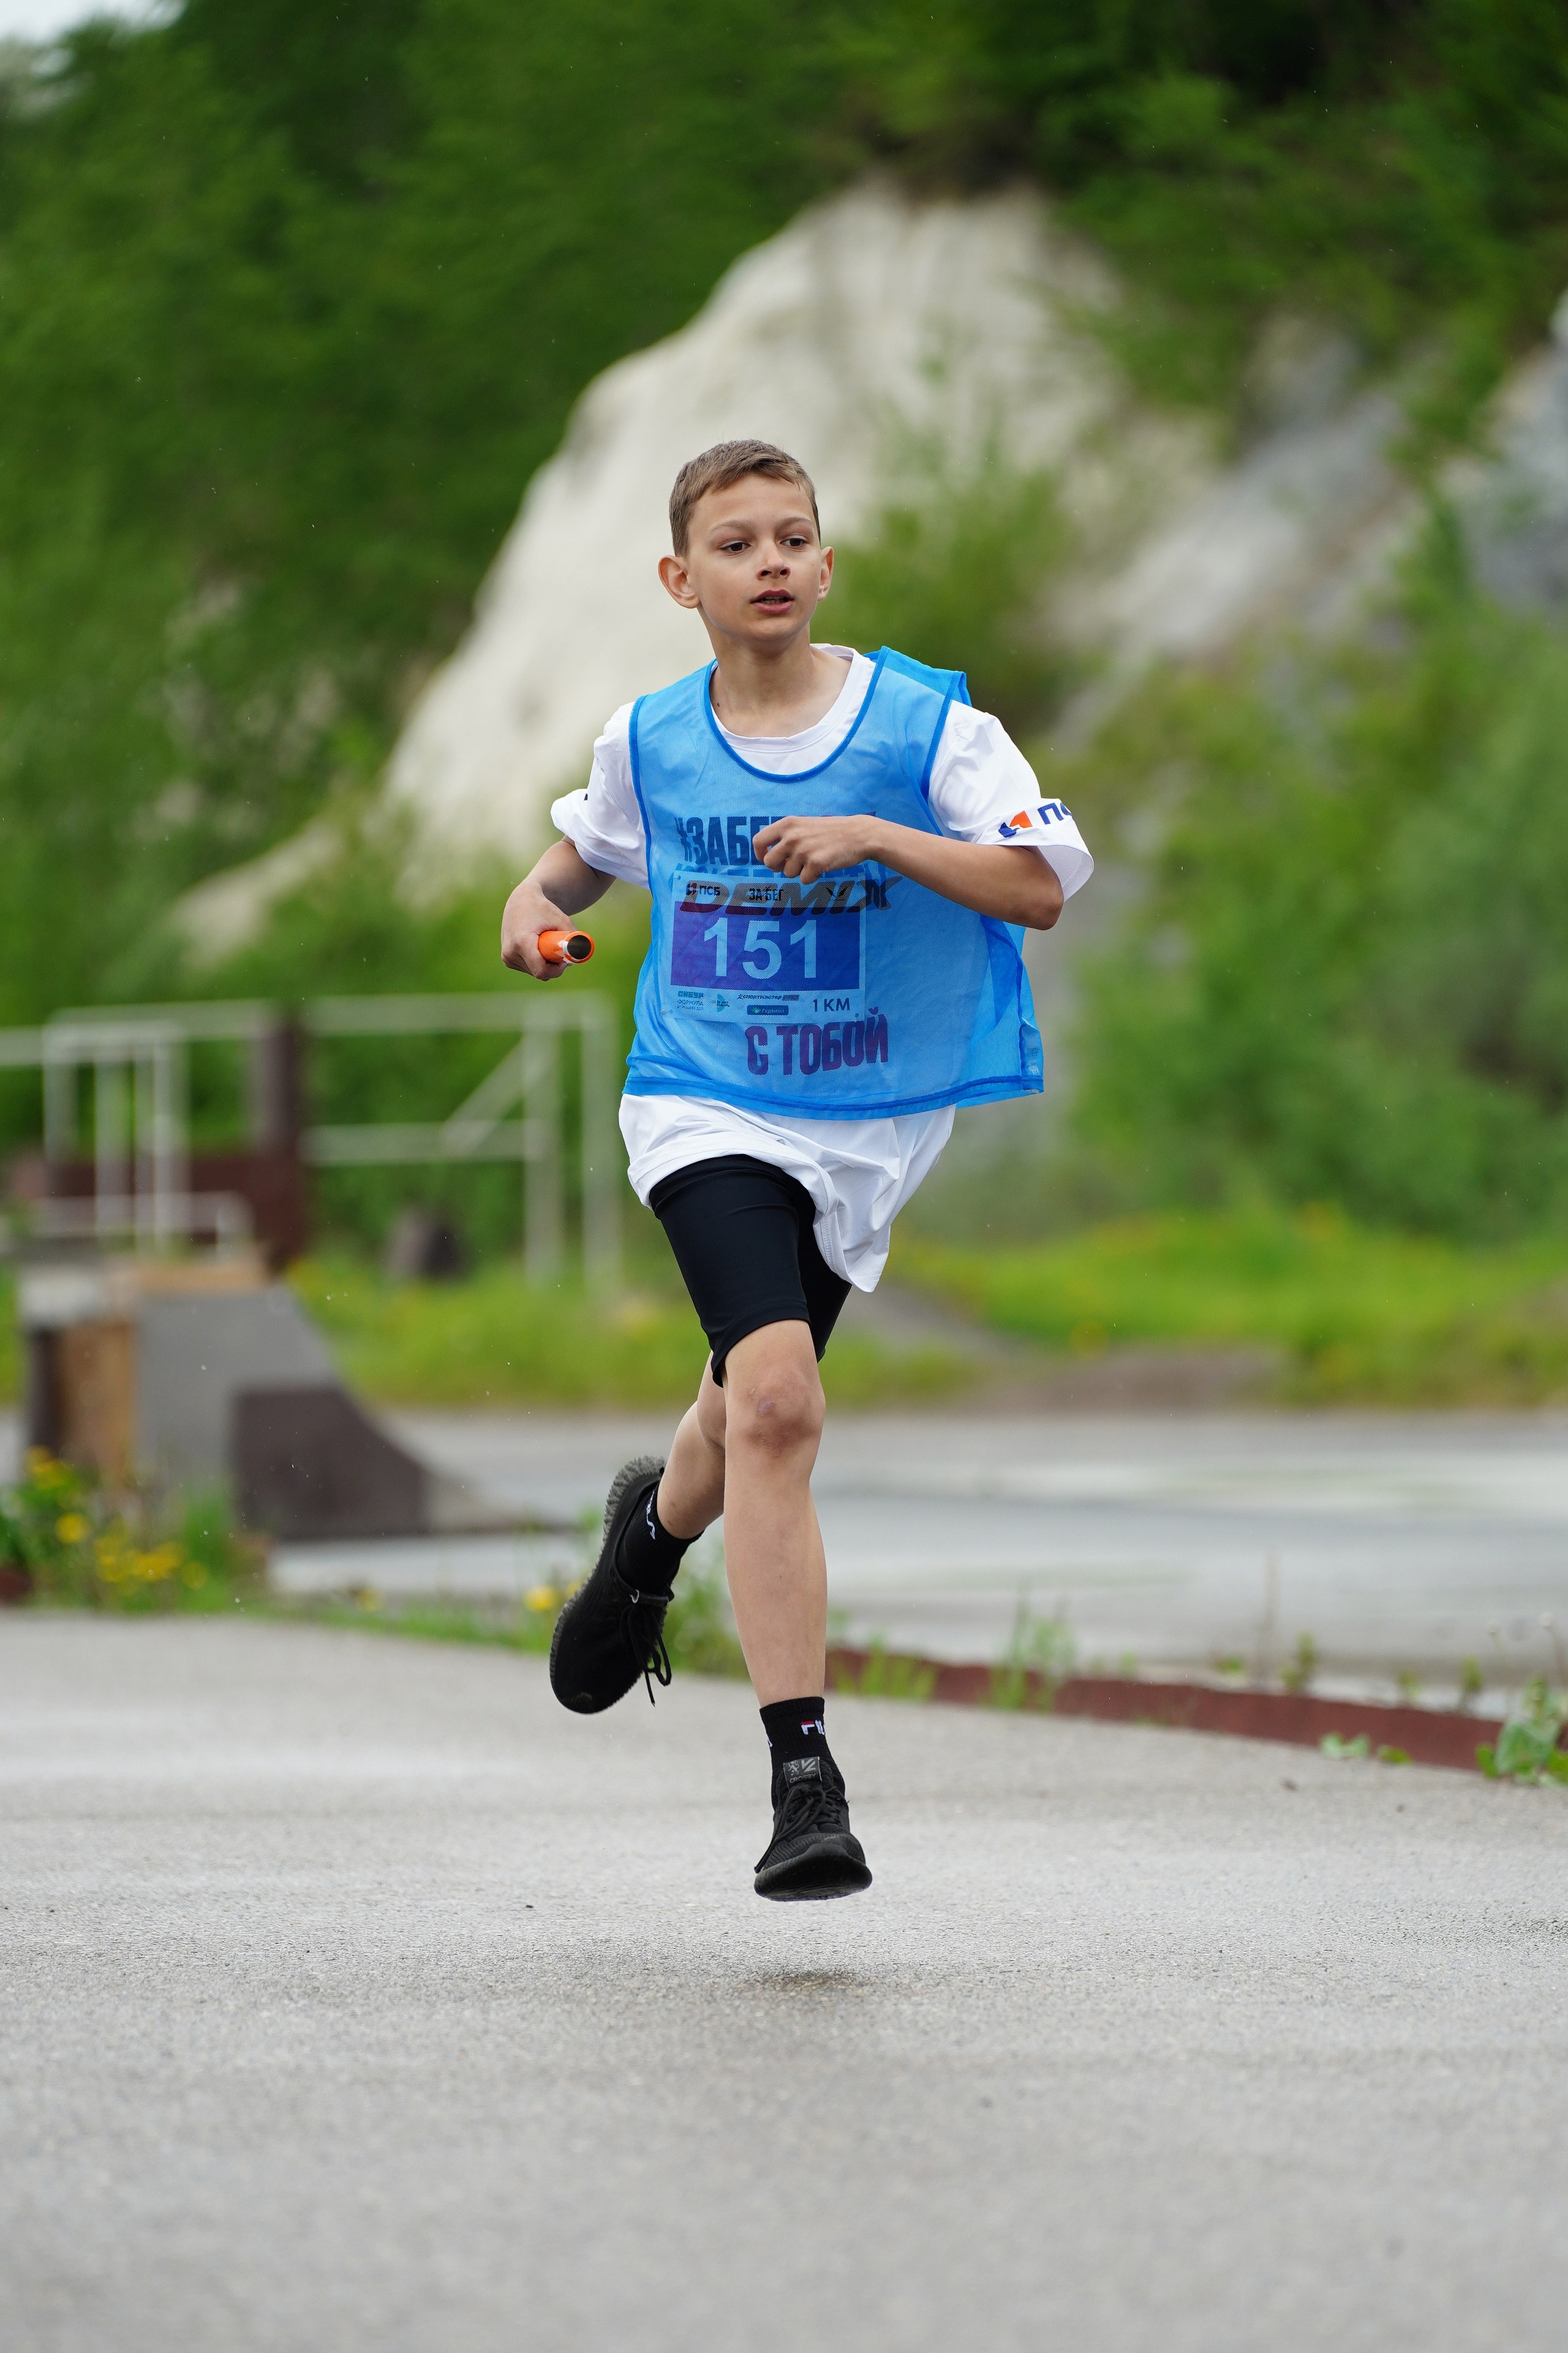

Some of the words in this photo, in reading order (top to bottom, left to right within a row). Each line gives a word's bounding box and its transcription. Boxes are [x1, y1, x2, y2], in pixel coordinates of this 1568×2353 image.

[680, 875, 903, 916] DEMIX
[699, 885, 721, 896] ПСБ
[704, 916, 817, 980] 151
[812, 999, 819, 1012] 1
[744, 1025, 769, 1076] С
[776, 1006, 889, 1076] ТОБОЙ
